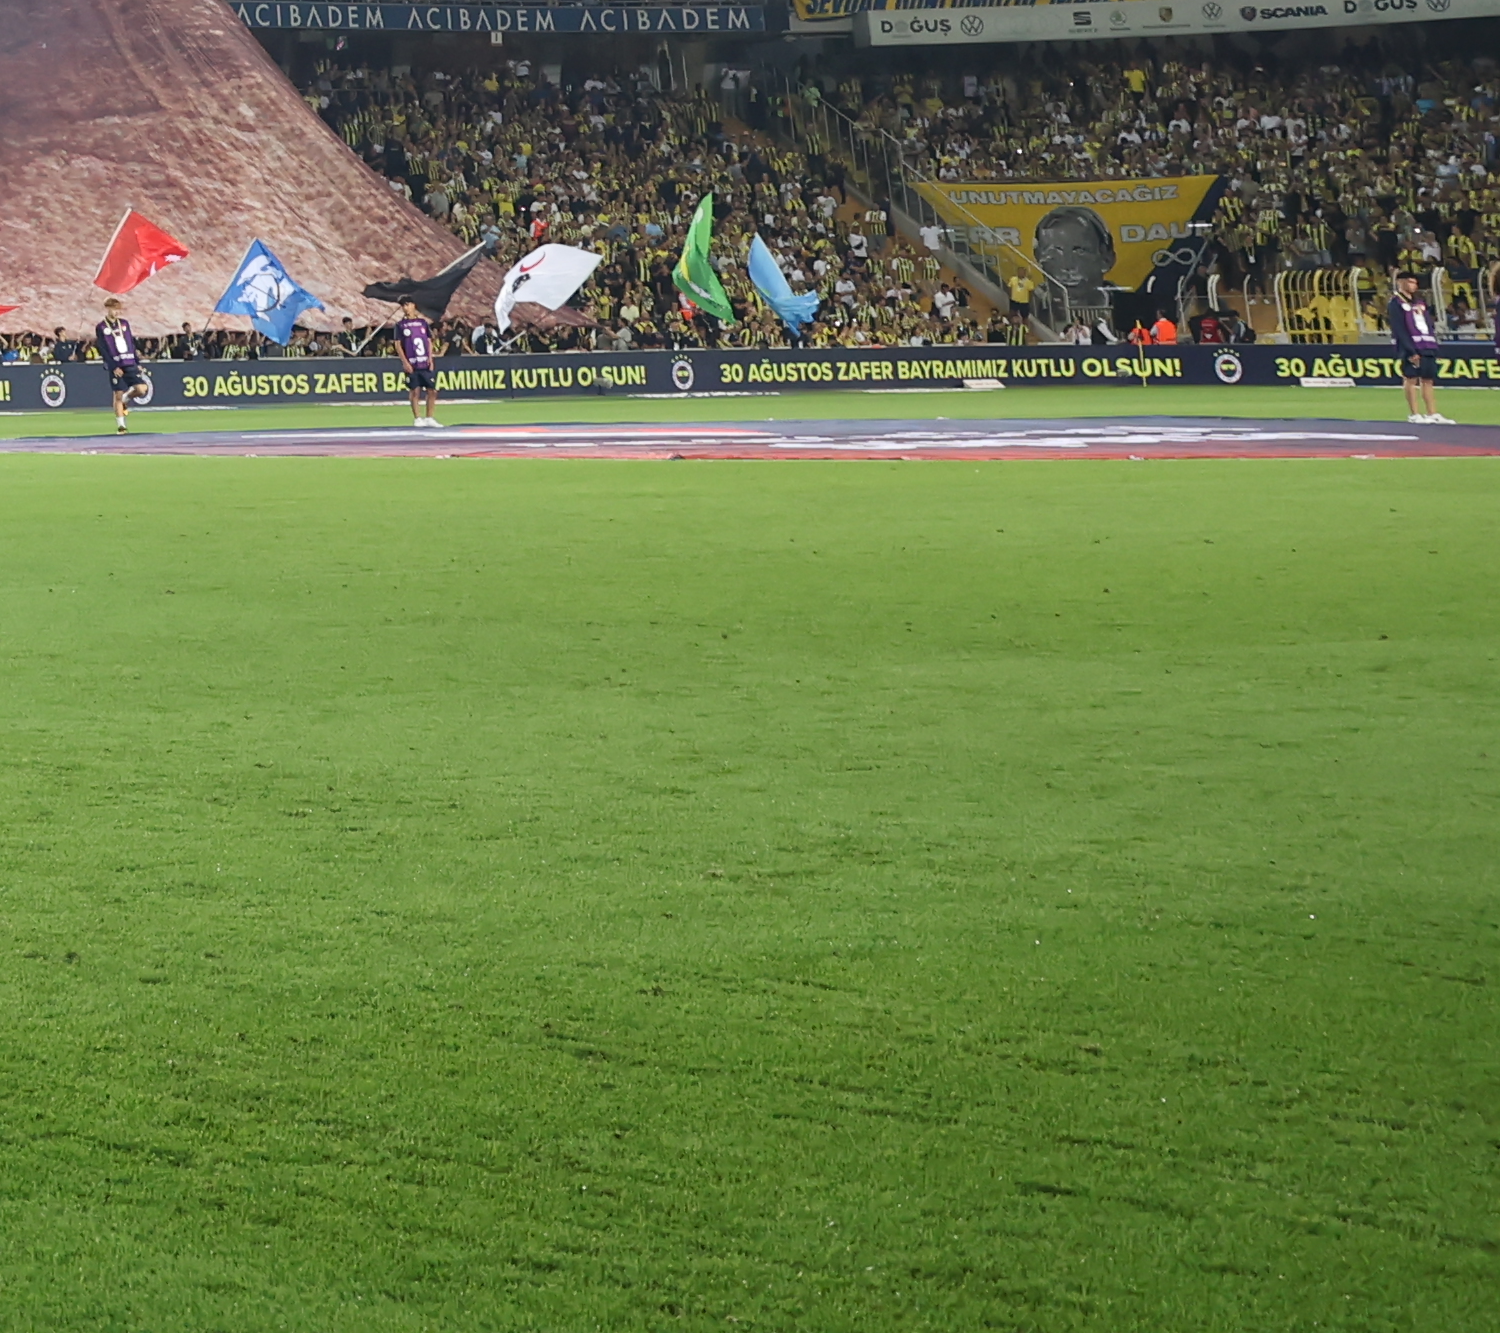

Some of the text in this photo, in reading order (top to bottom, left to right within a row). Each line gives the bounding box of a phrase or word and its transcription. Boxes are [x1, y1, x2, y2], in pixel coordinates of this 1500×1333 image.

[238, 4, 750, 31] ACIBADEM ACIBADEM ACIBADEM
[1259, 5, 1329, 20] SCANIA
[949, 184, 1179, 205] UNUTMAYACAĞIZ
[413, 337, 426, 356] 3
[720, 357, 1182, 384] 30 AĞUSTOS ZAFER BAYRAMIMIZ KUTLU OLSUN!
[1275, 357, 1305, 378] 30
[1312, 353, 1405, 379] AĞUST
[182, 375, 210, 398] 30
[214, 370, 310, 397] AĞUSTOS
[314, 372, 383, 394] ZAFER
[386, 369, 506, 393] BAAMIMIZ
[511, 366, 572, 389] KUTLU
